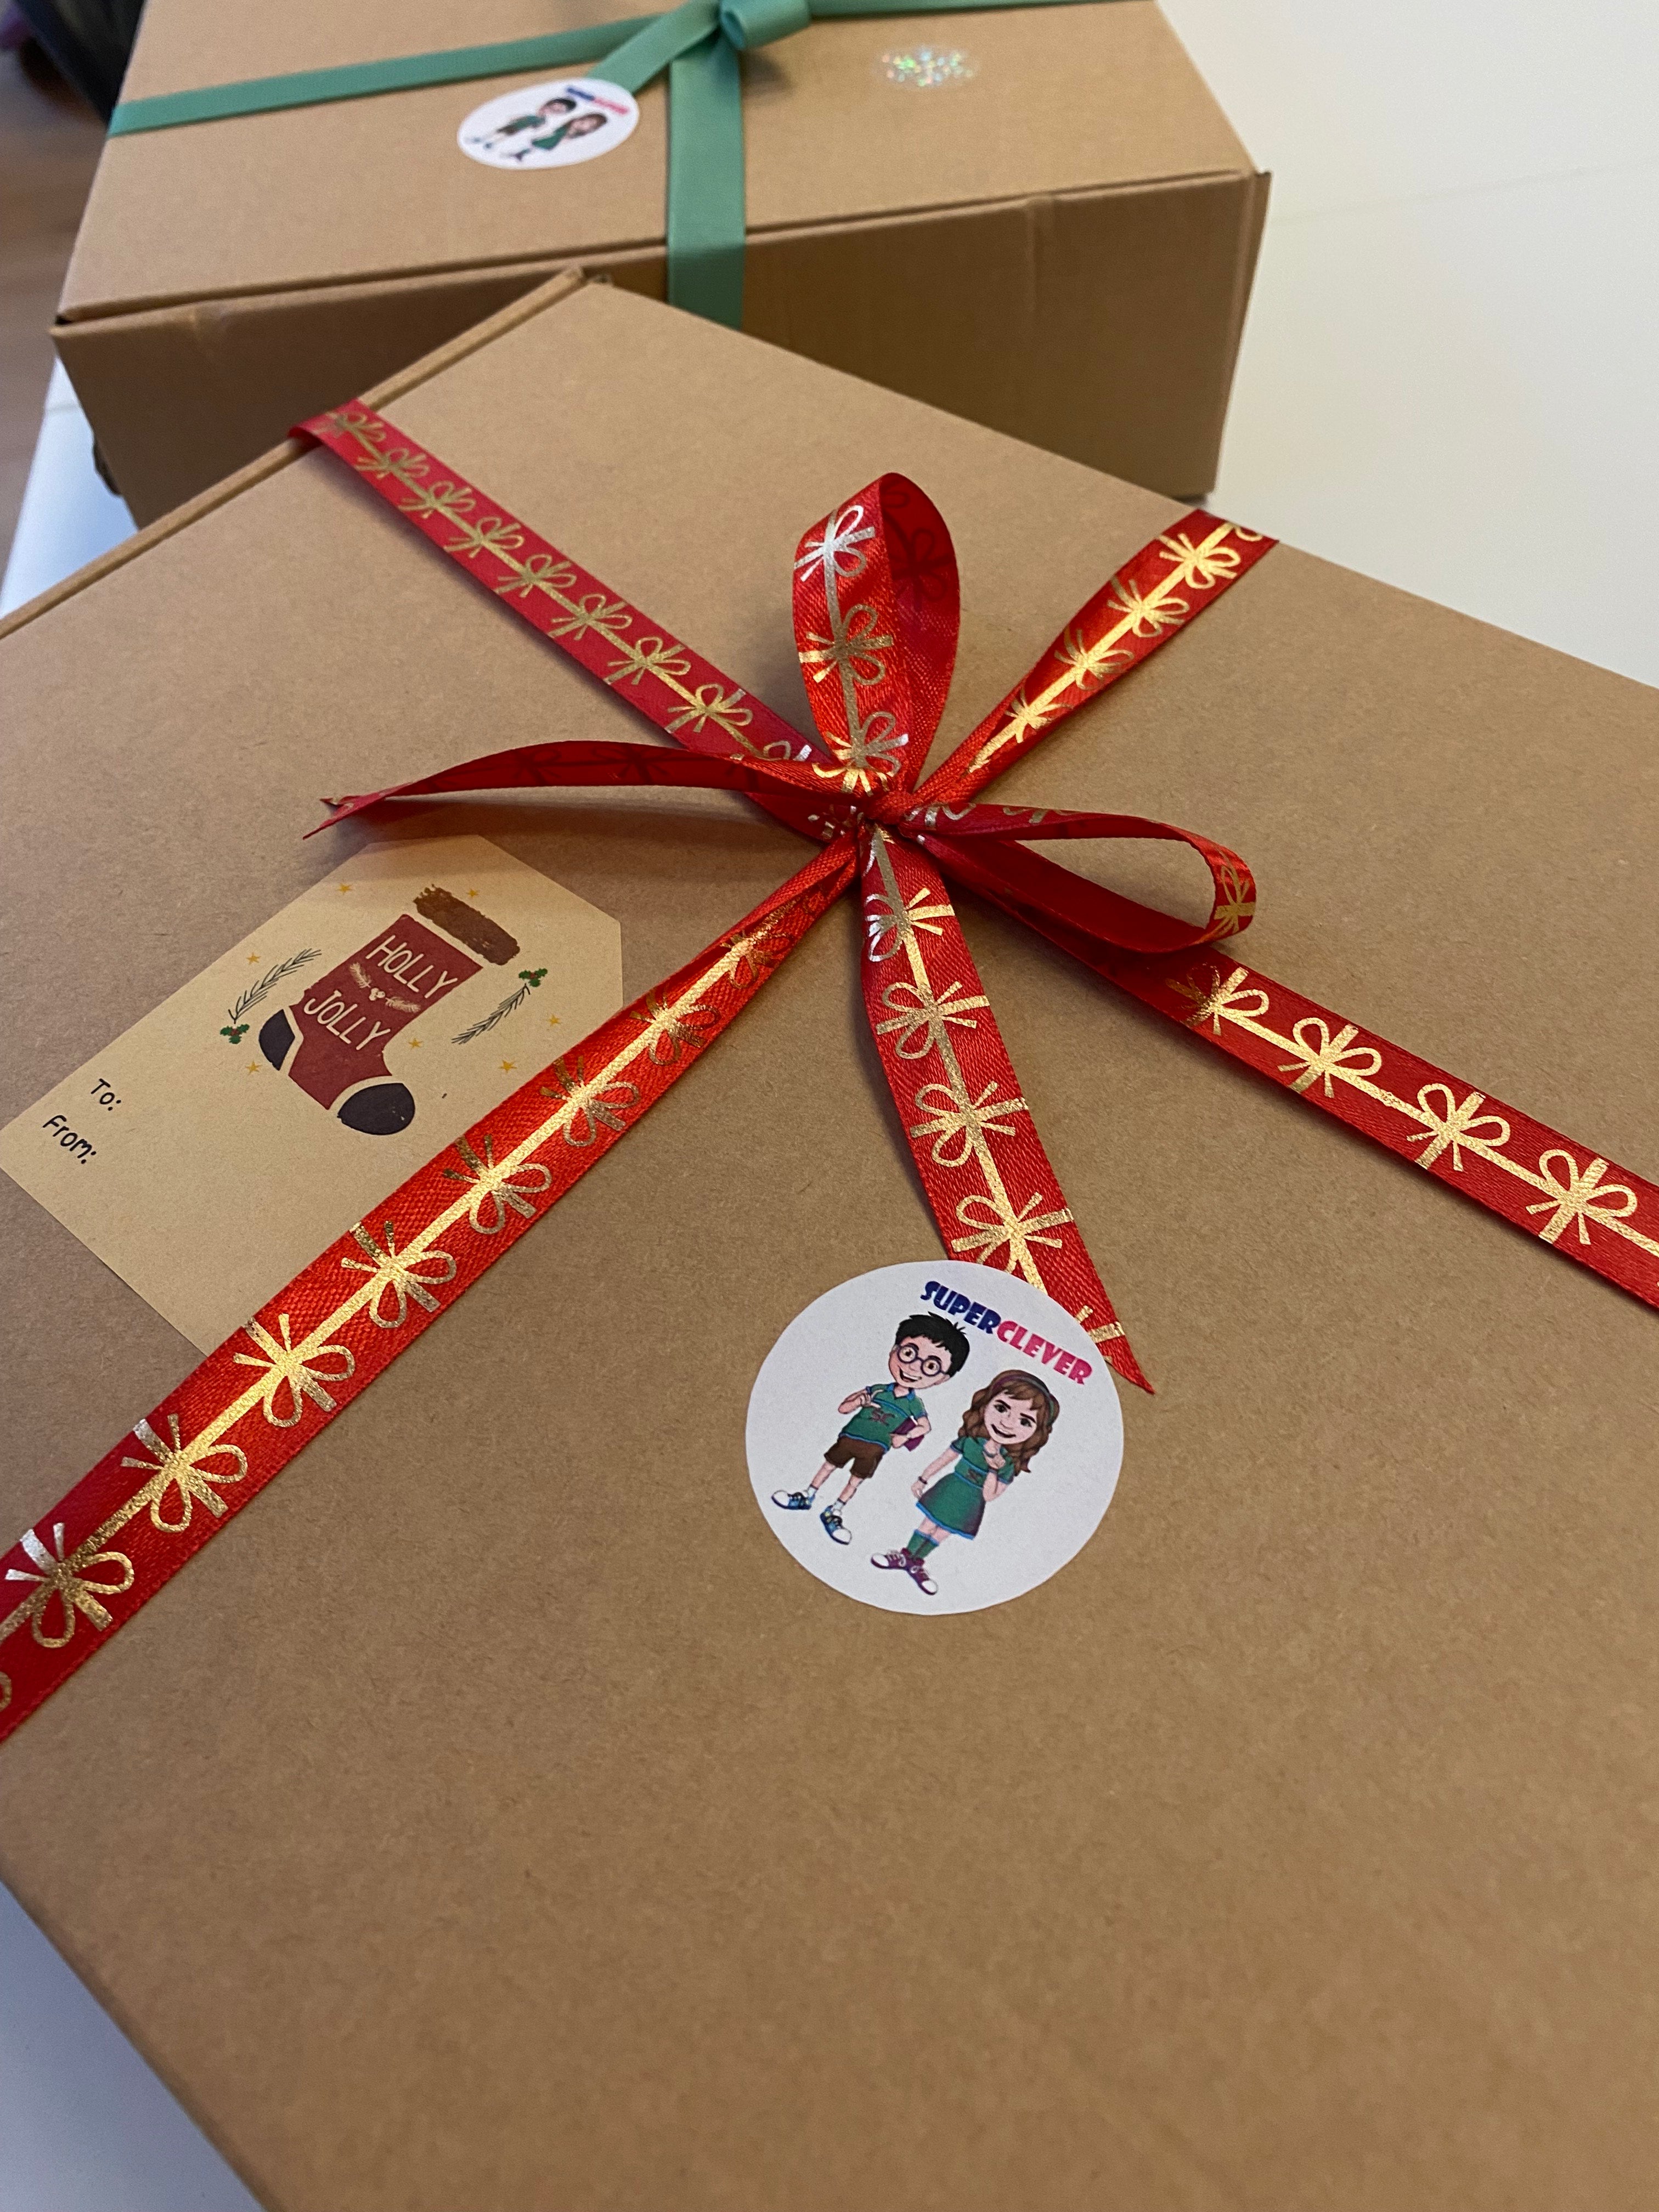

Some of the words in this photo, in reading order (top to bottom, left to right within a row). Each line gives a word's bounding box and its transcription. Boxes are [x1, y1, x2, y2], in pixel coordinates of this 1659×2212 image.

[365, 935, 458, 998] HOLLY
[303, 990, 391, 1051] JOLLY
[91, 1078, 121, 1111] To:
[42, 1115, 97, 1164] From:
[920, 1280, 1093, 1385] SUPERCLEVER
